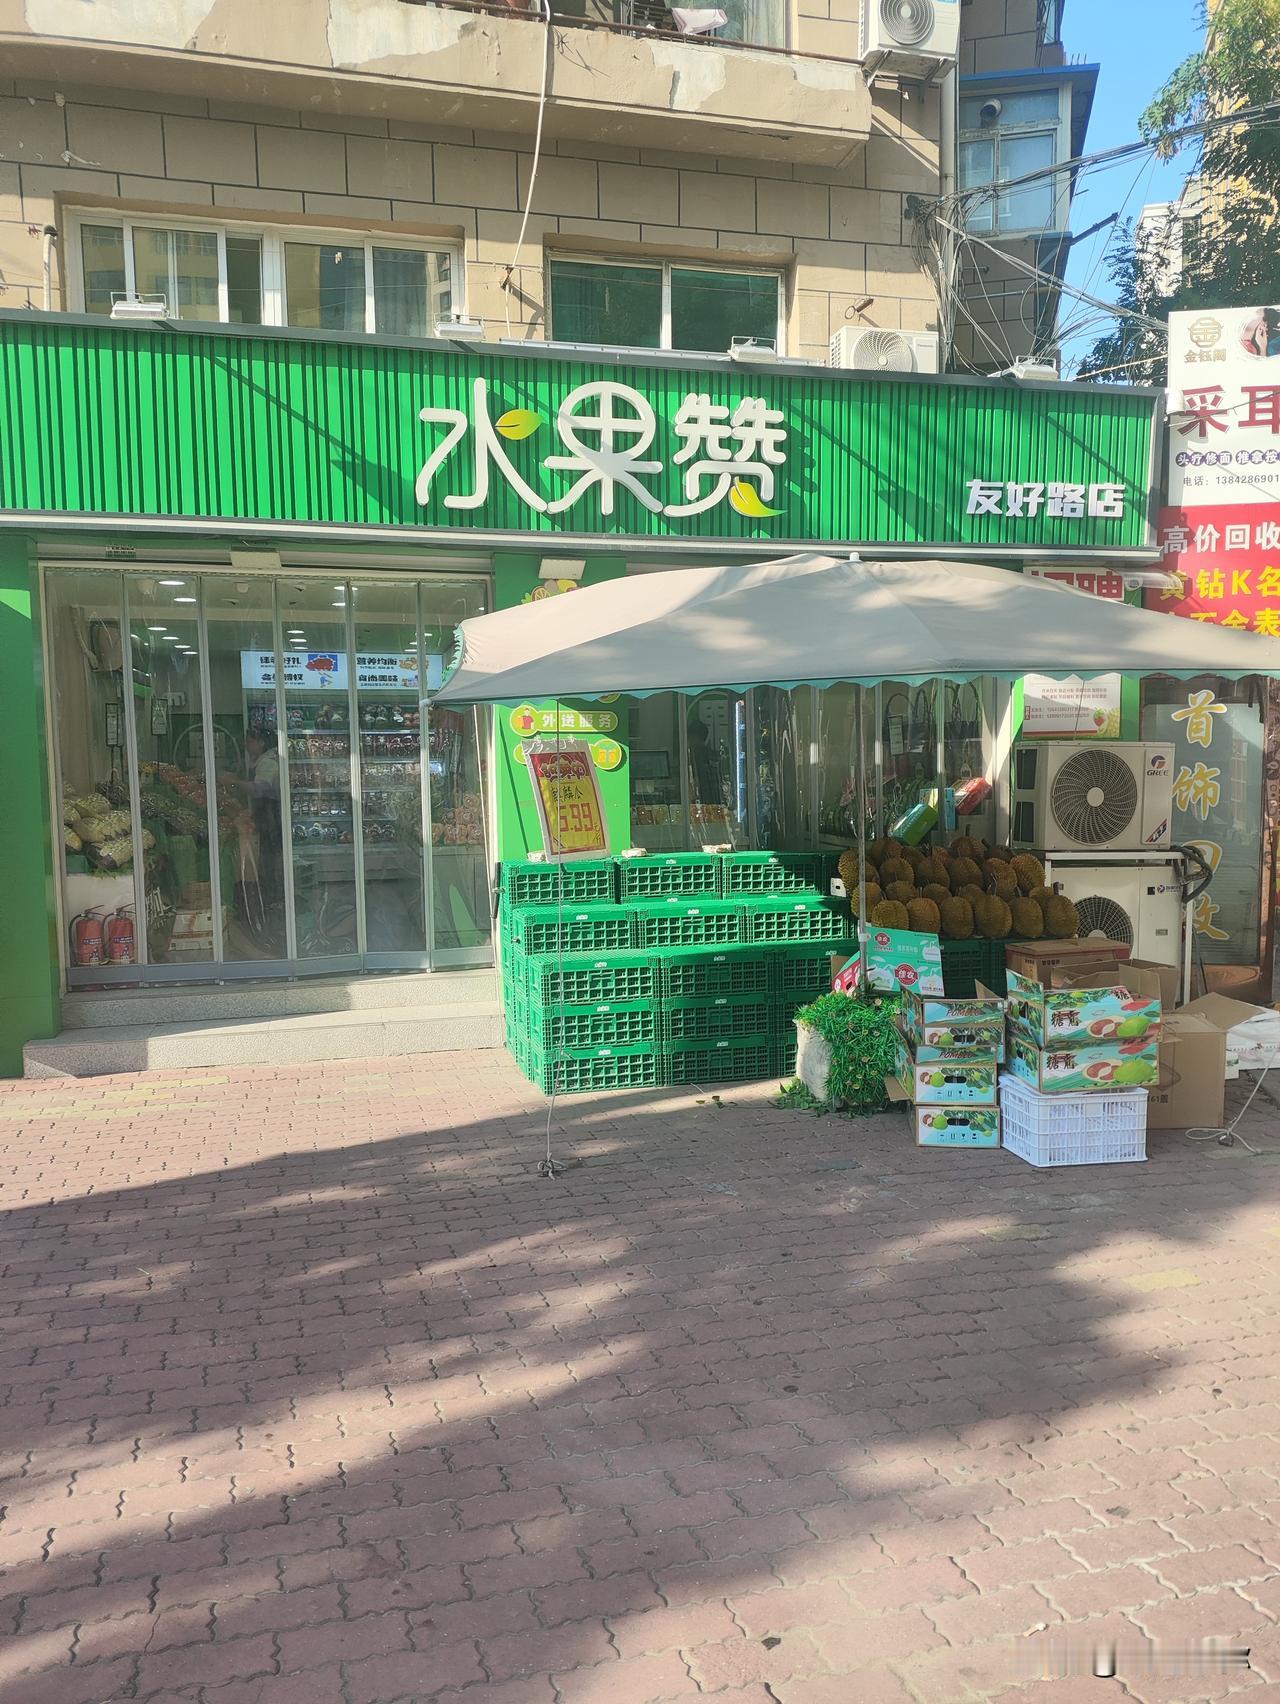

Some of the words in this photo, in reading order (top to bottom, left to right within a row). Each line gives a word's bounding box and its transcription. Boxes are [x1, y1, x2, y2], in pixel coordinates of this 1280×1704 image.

[415, 377, 787, 518] 水果赞
[1177, 452, 1232, 467] 头疗修面
[966, 479, 1126, 518] 友好路店
[1163, 521, 1280, 554] 高价回收
[542, 713, 611, 728] 外送服务
[1146, 769, 1169, 777] GREE
[556, 803, 594, 832] 5.99
